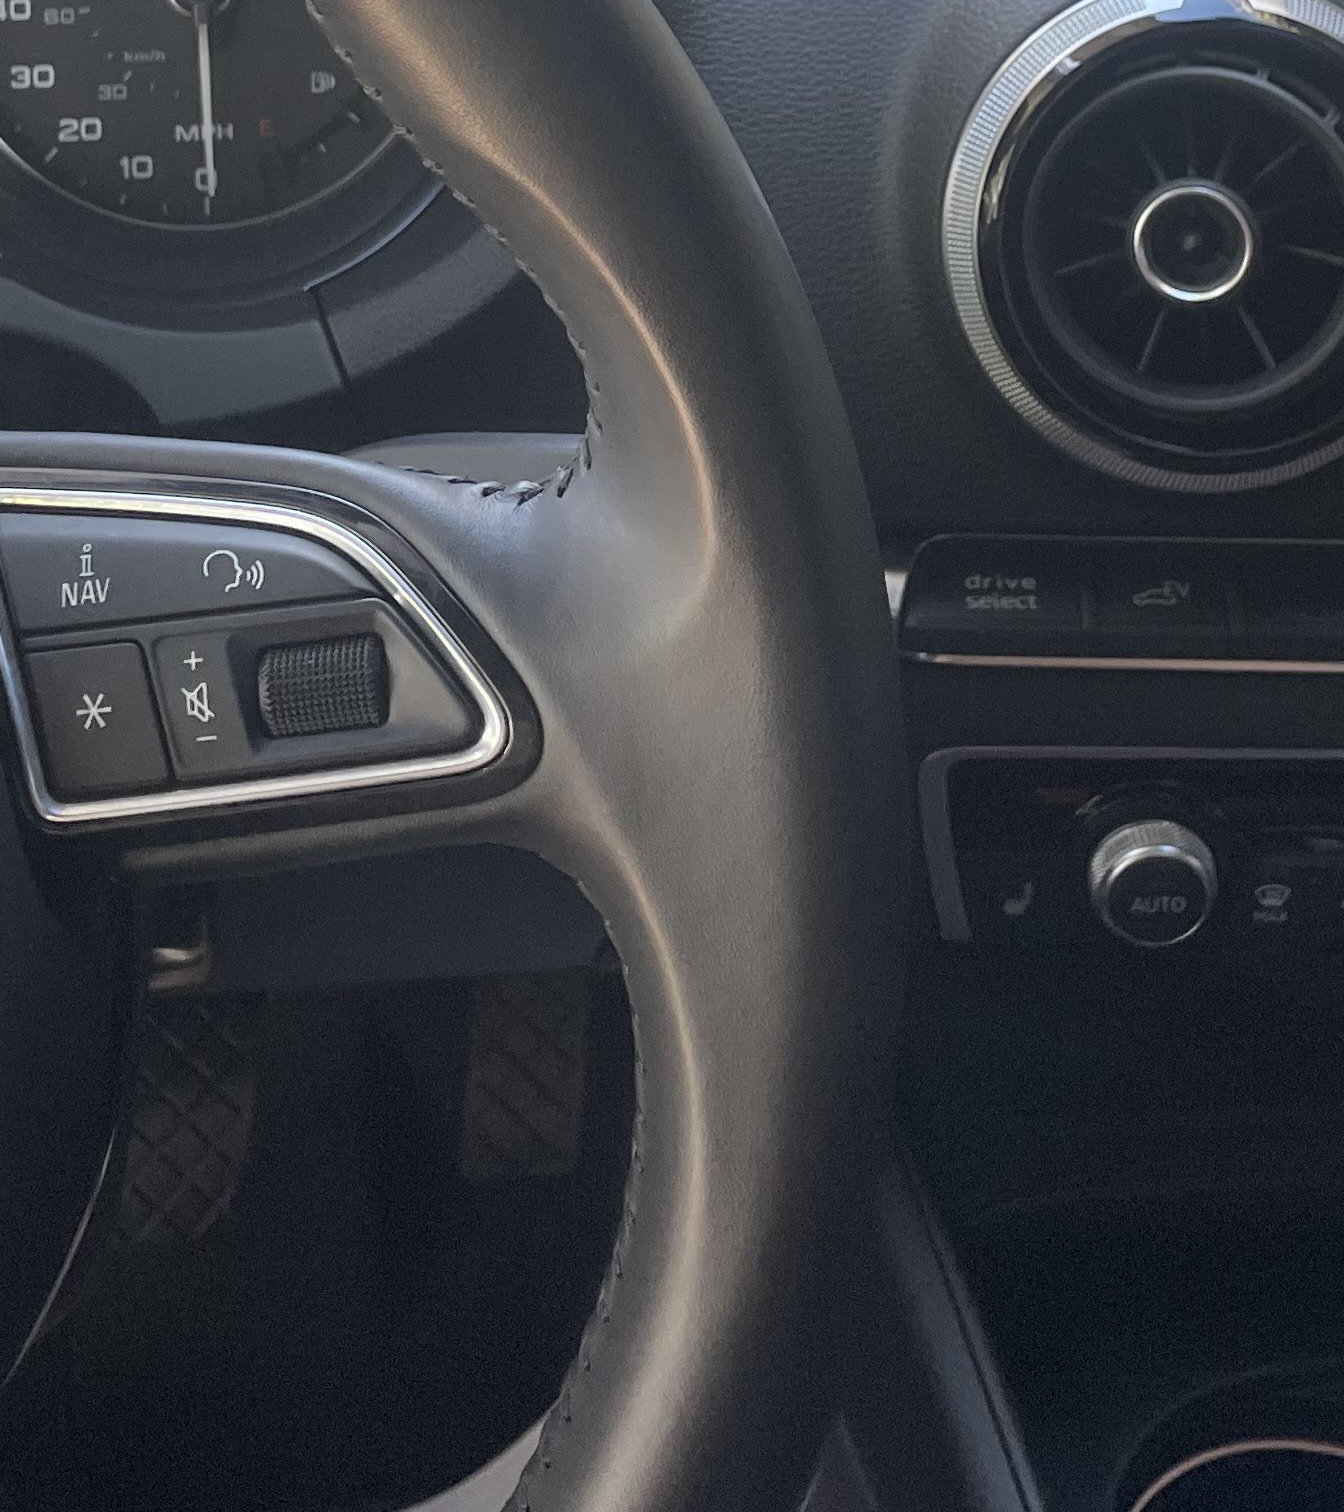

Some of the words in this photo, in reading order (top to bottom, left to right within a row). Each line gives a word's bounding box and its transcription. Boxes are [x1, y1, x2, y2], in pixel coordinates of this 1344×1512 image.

[10, 64, 55, 90] 30
[58, 116, 103, 142] 20
[119, 154, 154, 180] 10
[60, 576, 111, 608] NAV
[963, 572, 1038, 591] drive
[964, 591, 1039, 611] select
[1129, 895, 1187, 916] AUTO
